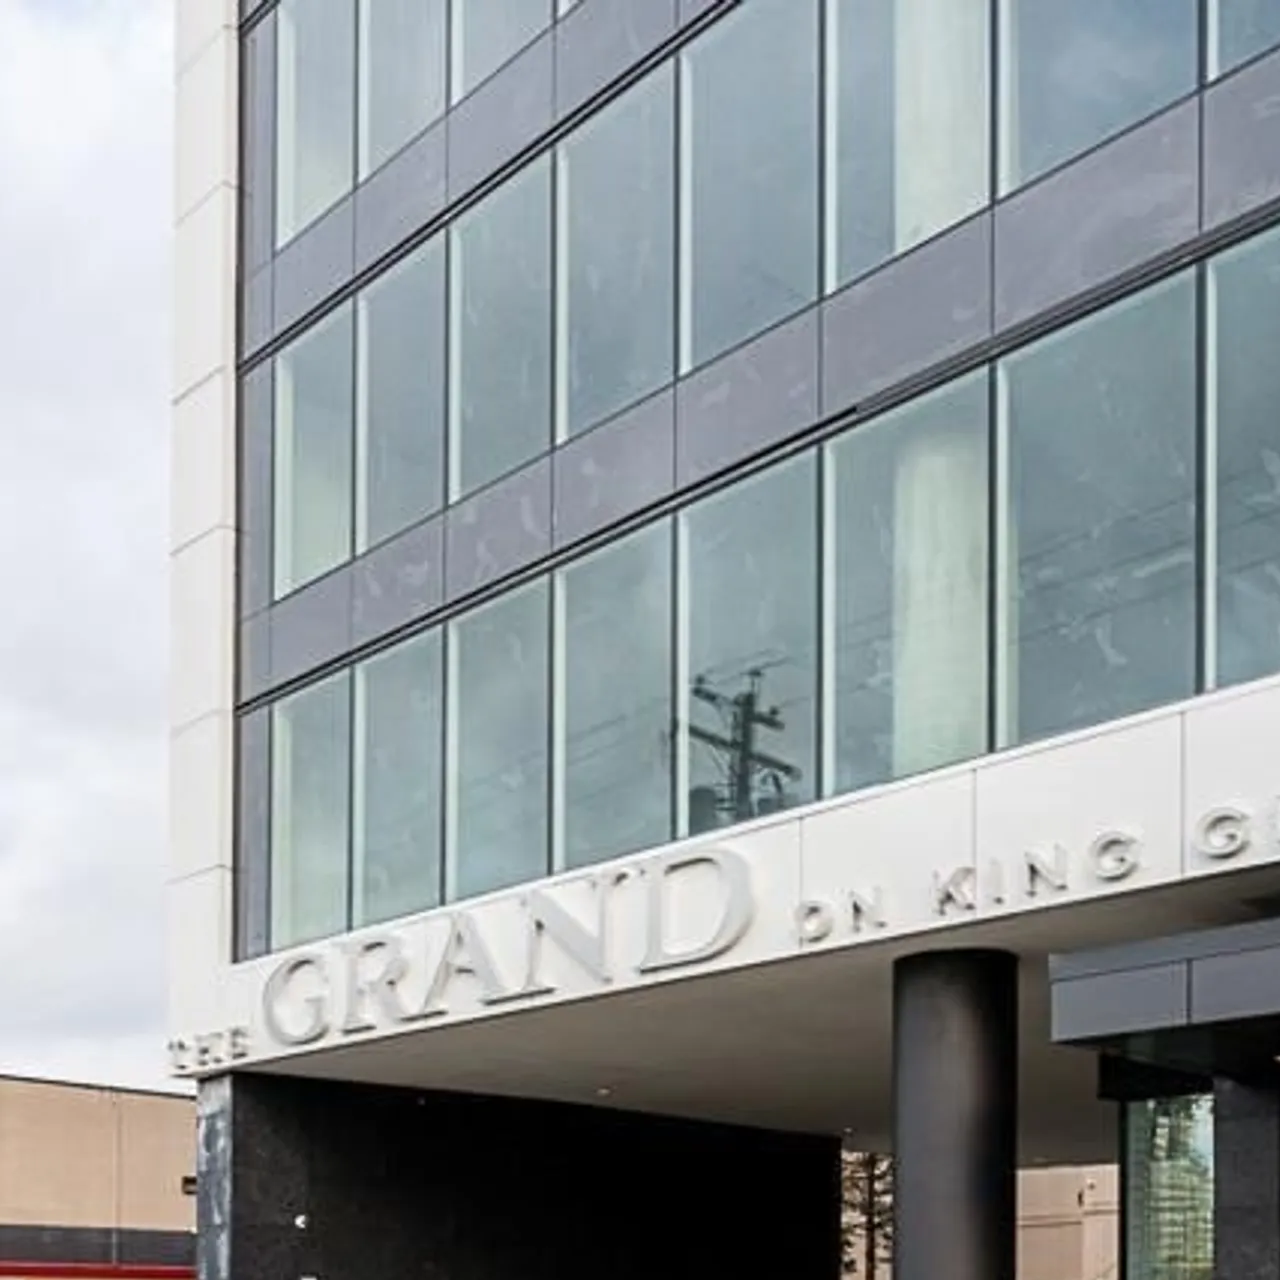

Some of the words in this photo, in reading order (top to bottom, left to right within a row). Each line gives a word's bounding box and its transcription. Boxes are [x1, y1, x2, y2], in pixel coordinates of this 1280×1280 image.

[261, 846, 755, 1046] GRAND
[795, 884, 888, 943] ON
[931, 832, 1141, 916] KING
